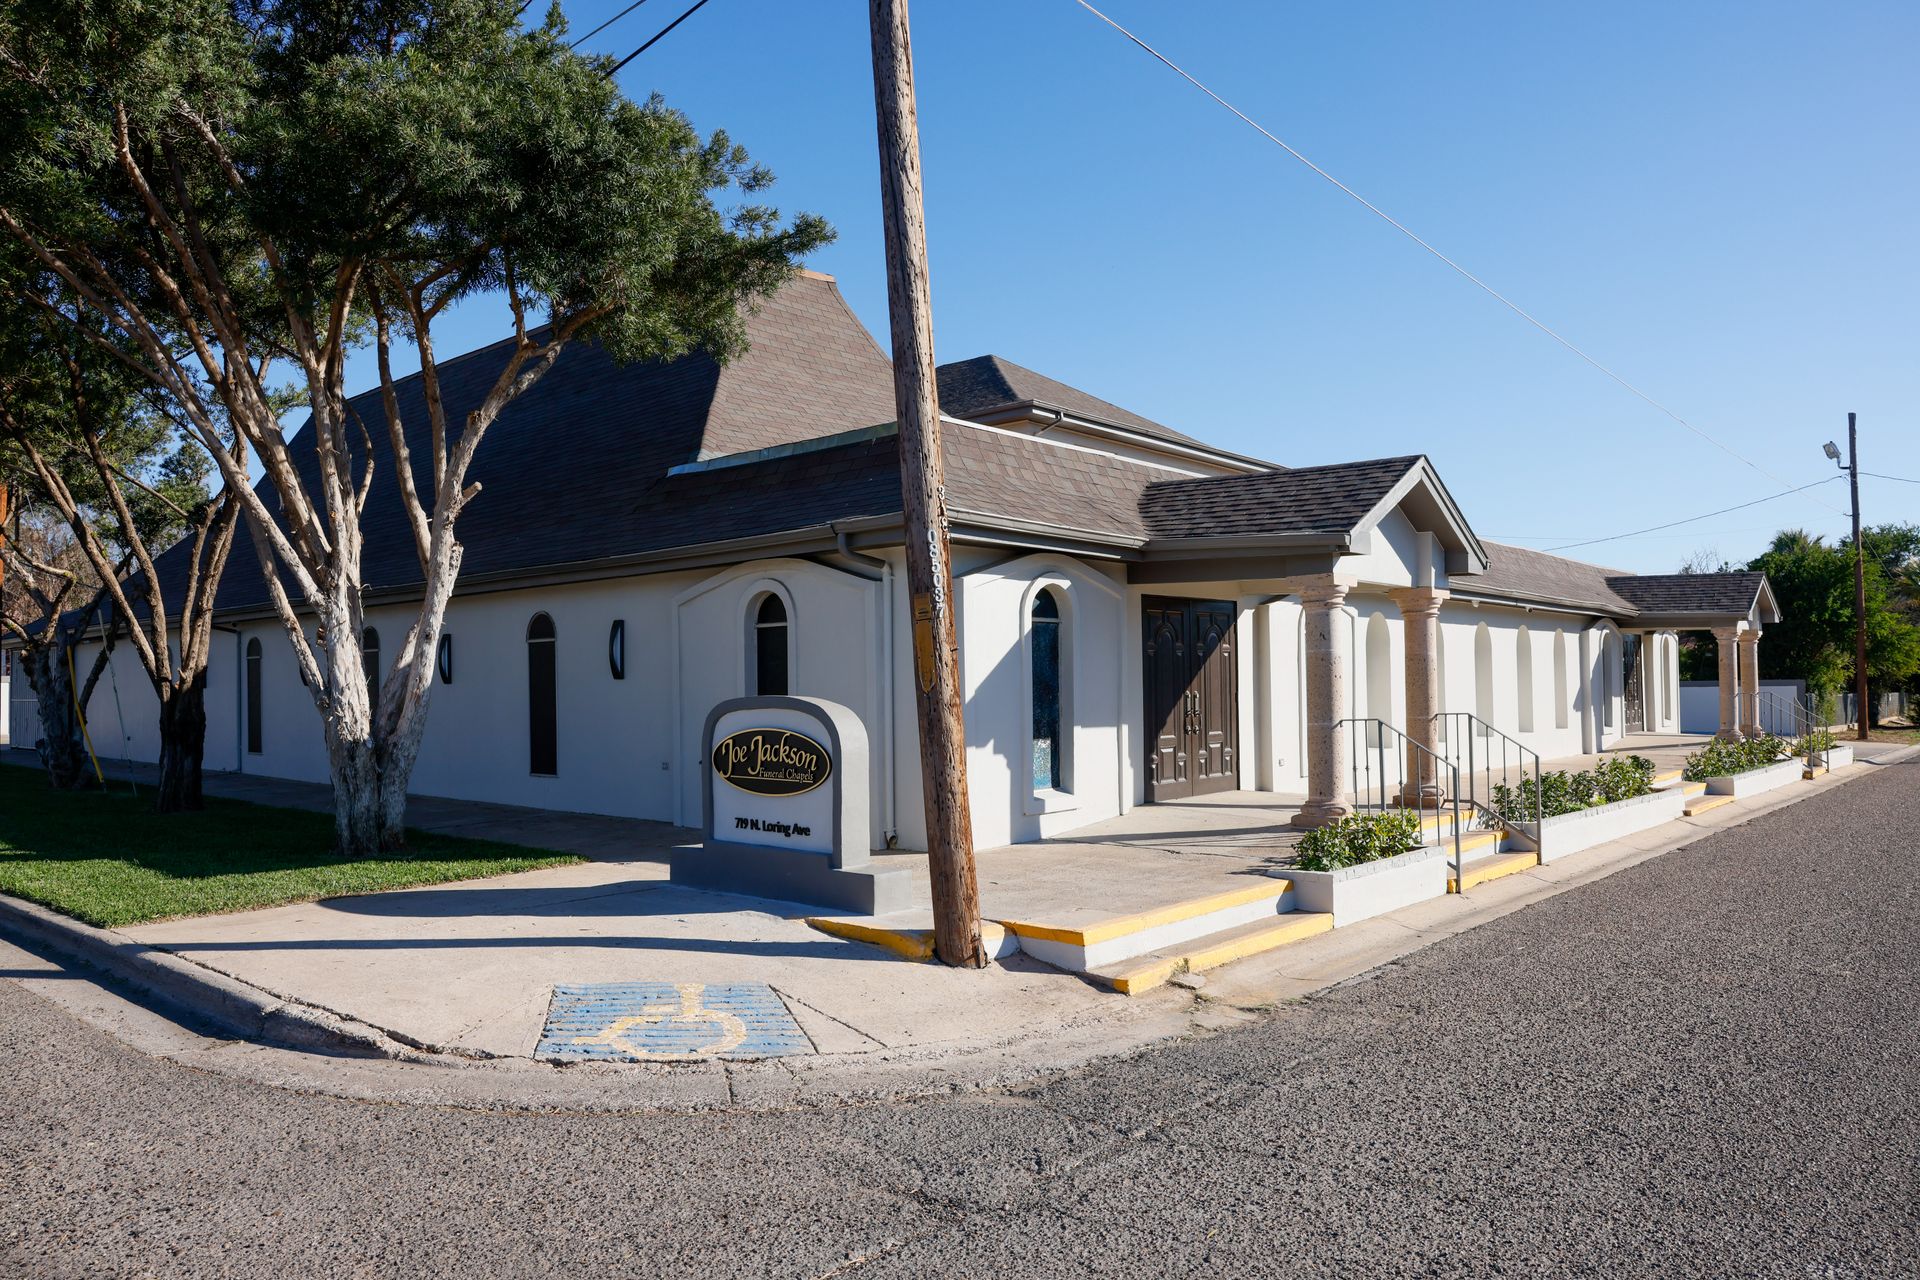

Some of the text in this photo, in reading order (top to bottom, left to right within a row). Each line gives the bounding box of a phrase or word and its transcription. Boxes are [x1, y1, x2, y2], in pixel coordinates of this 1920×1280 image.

[720, 732, 817, 778] Joe Jackson
[759, 767, 814, 783] Funeral Chapels
[735, 817, 811, 837] 719 N. Loring Ave
